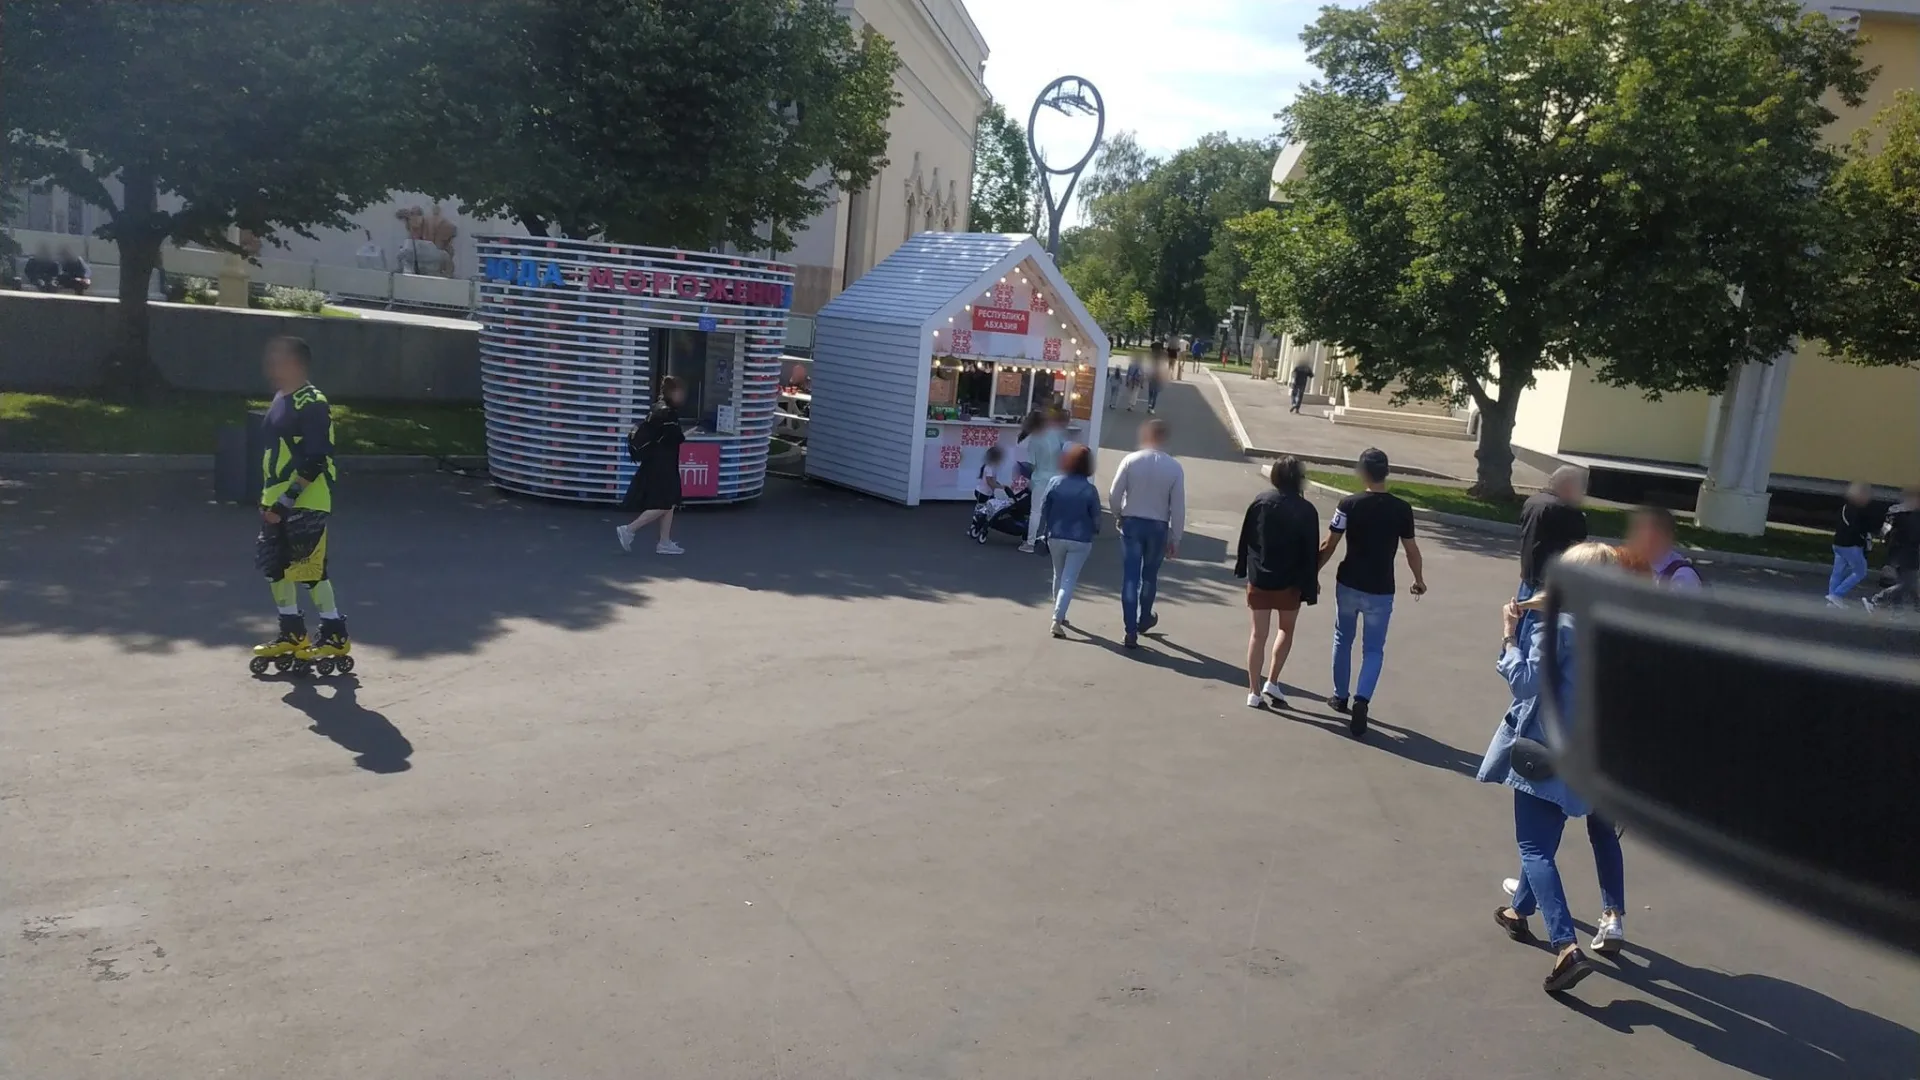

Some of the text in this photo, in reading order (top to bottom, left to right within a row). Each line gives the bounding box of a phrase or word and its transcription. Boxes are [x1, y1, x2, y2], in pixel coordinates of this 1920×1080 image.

[587, 266, 785, 307] МОРОЖЕНО
[977, 309, 1026, 322] РЕСПУБЛИКА
[983, 320, 1018, 331] АБХАЗИЯ
